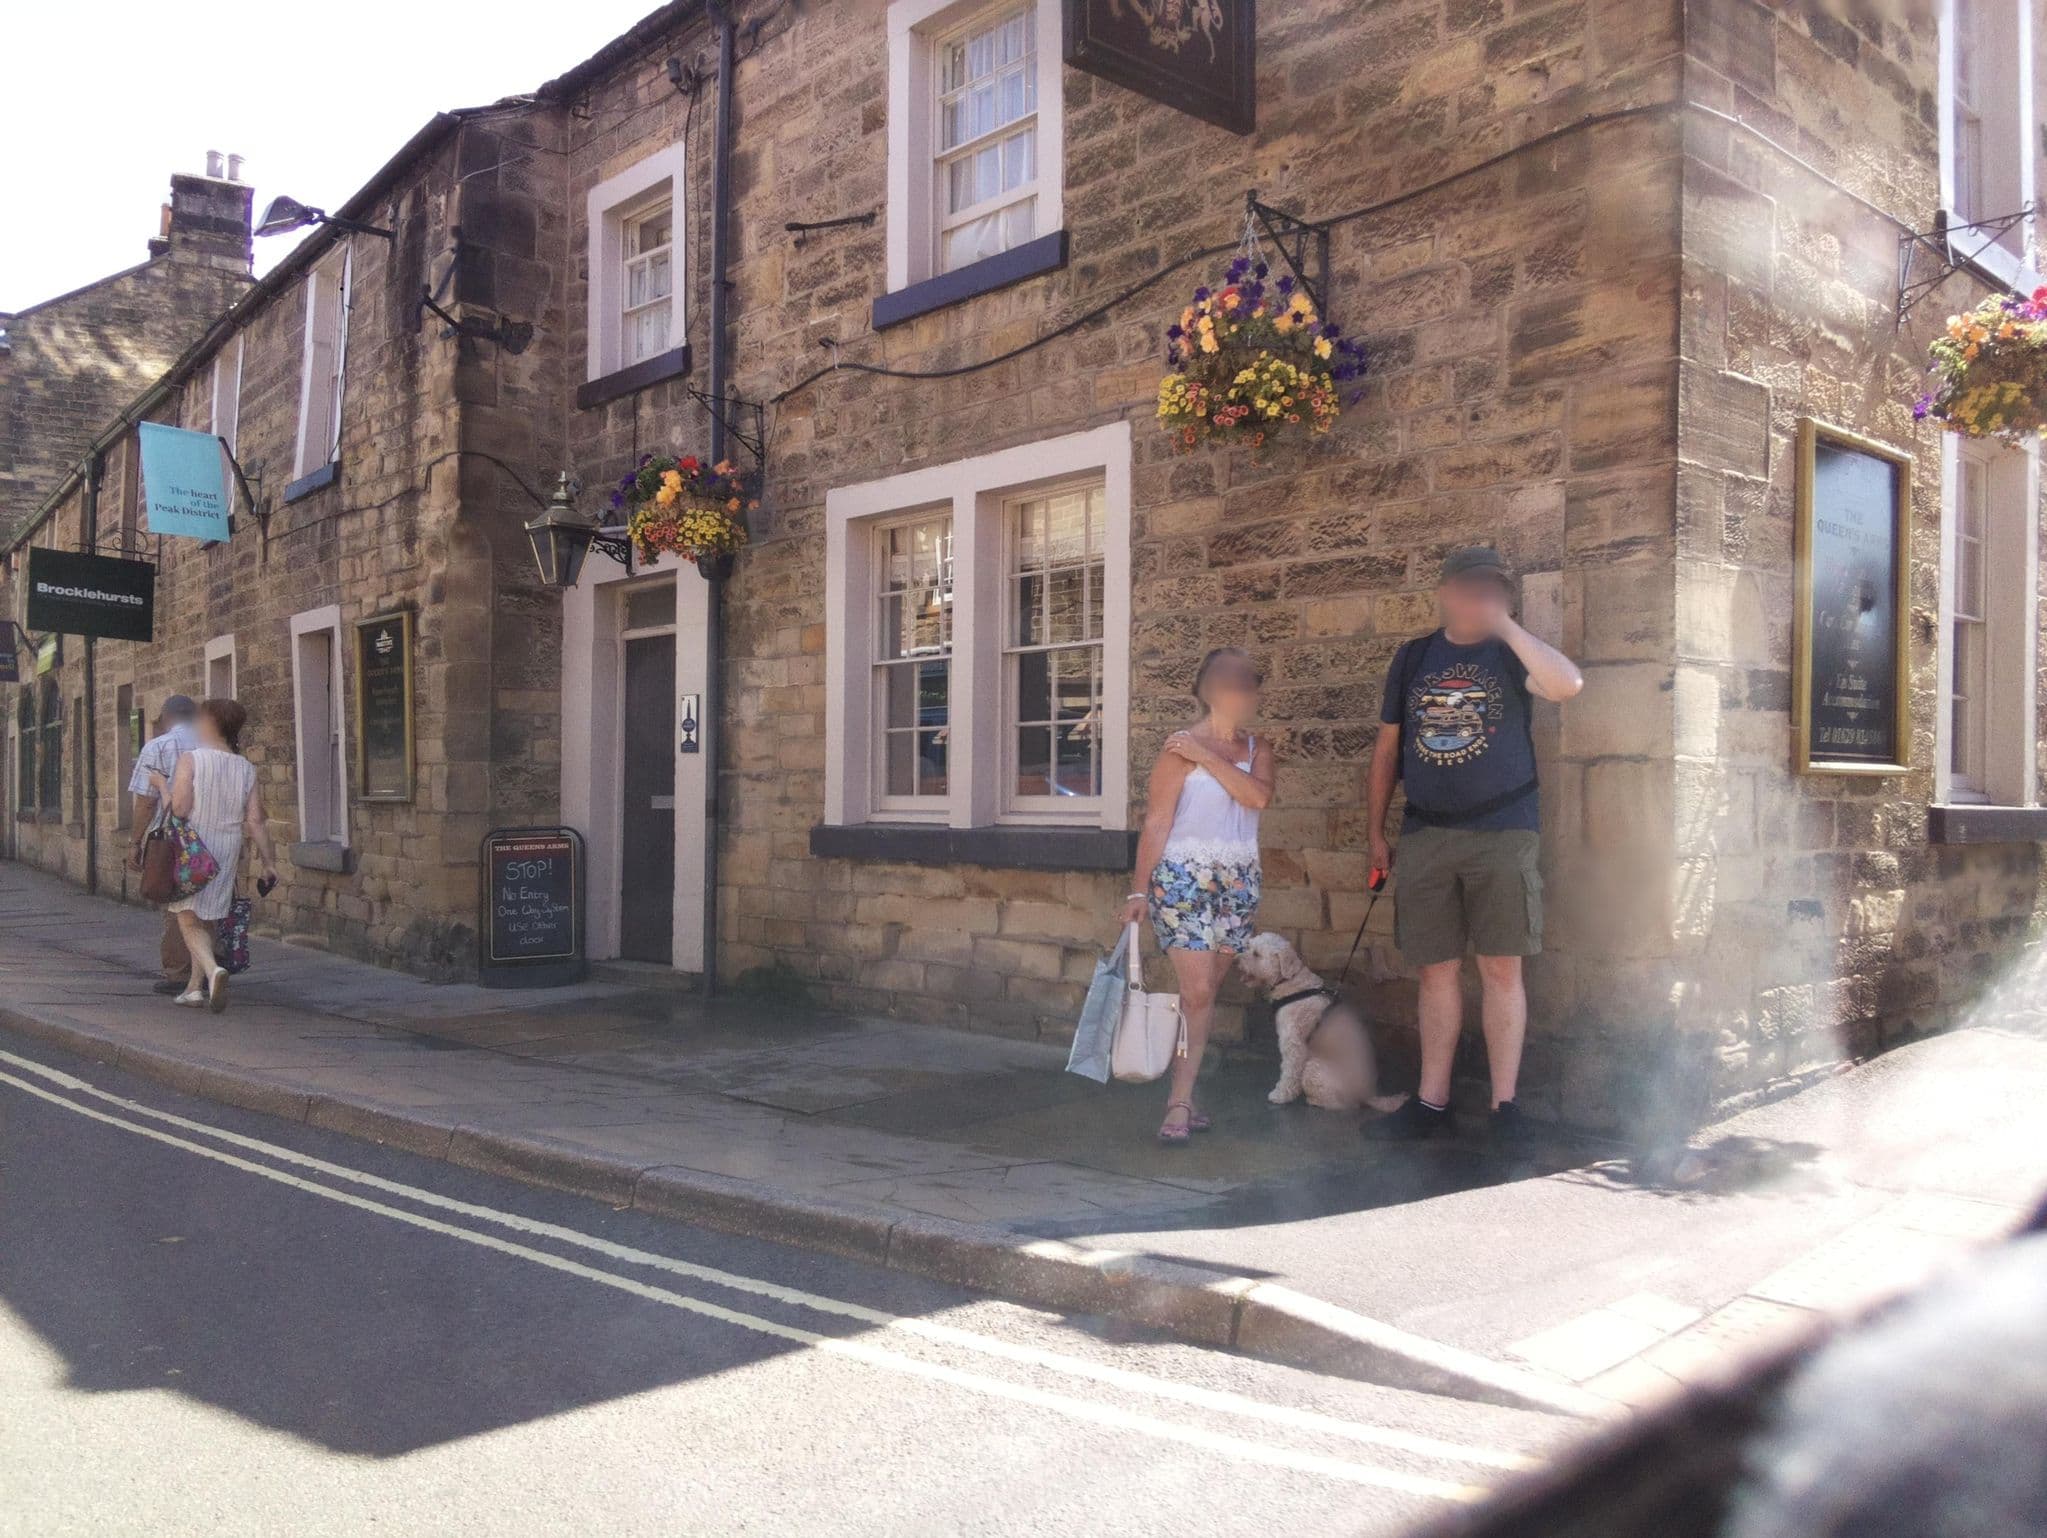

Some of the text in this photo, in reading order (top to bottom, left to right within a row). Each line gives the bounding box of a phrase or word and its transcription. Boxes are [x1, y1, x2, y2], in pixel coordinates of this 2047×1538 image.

[169, 485, 217, 500] The heart
[154, 503, 220, 520] Peak District
[190, 499, 219, 509] of the
[1844, 508, 1865, 526] THE
[36, 582, 144, 605] Brocklehursts
[1443, 749, 1467, 759] ROAD
[505, 858, 552, 880] STOP!
[502, 886, 550, 907] No Entry
[498, 905, 519, 917] One
[521, 904, 541, 919] Way
